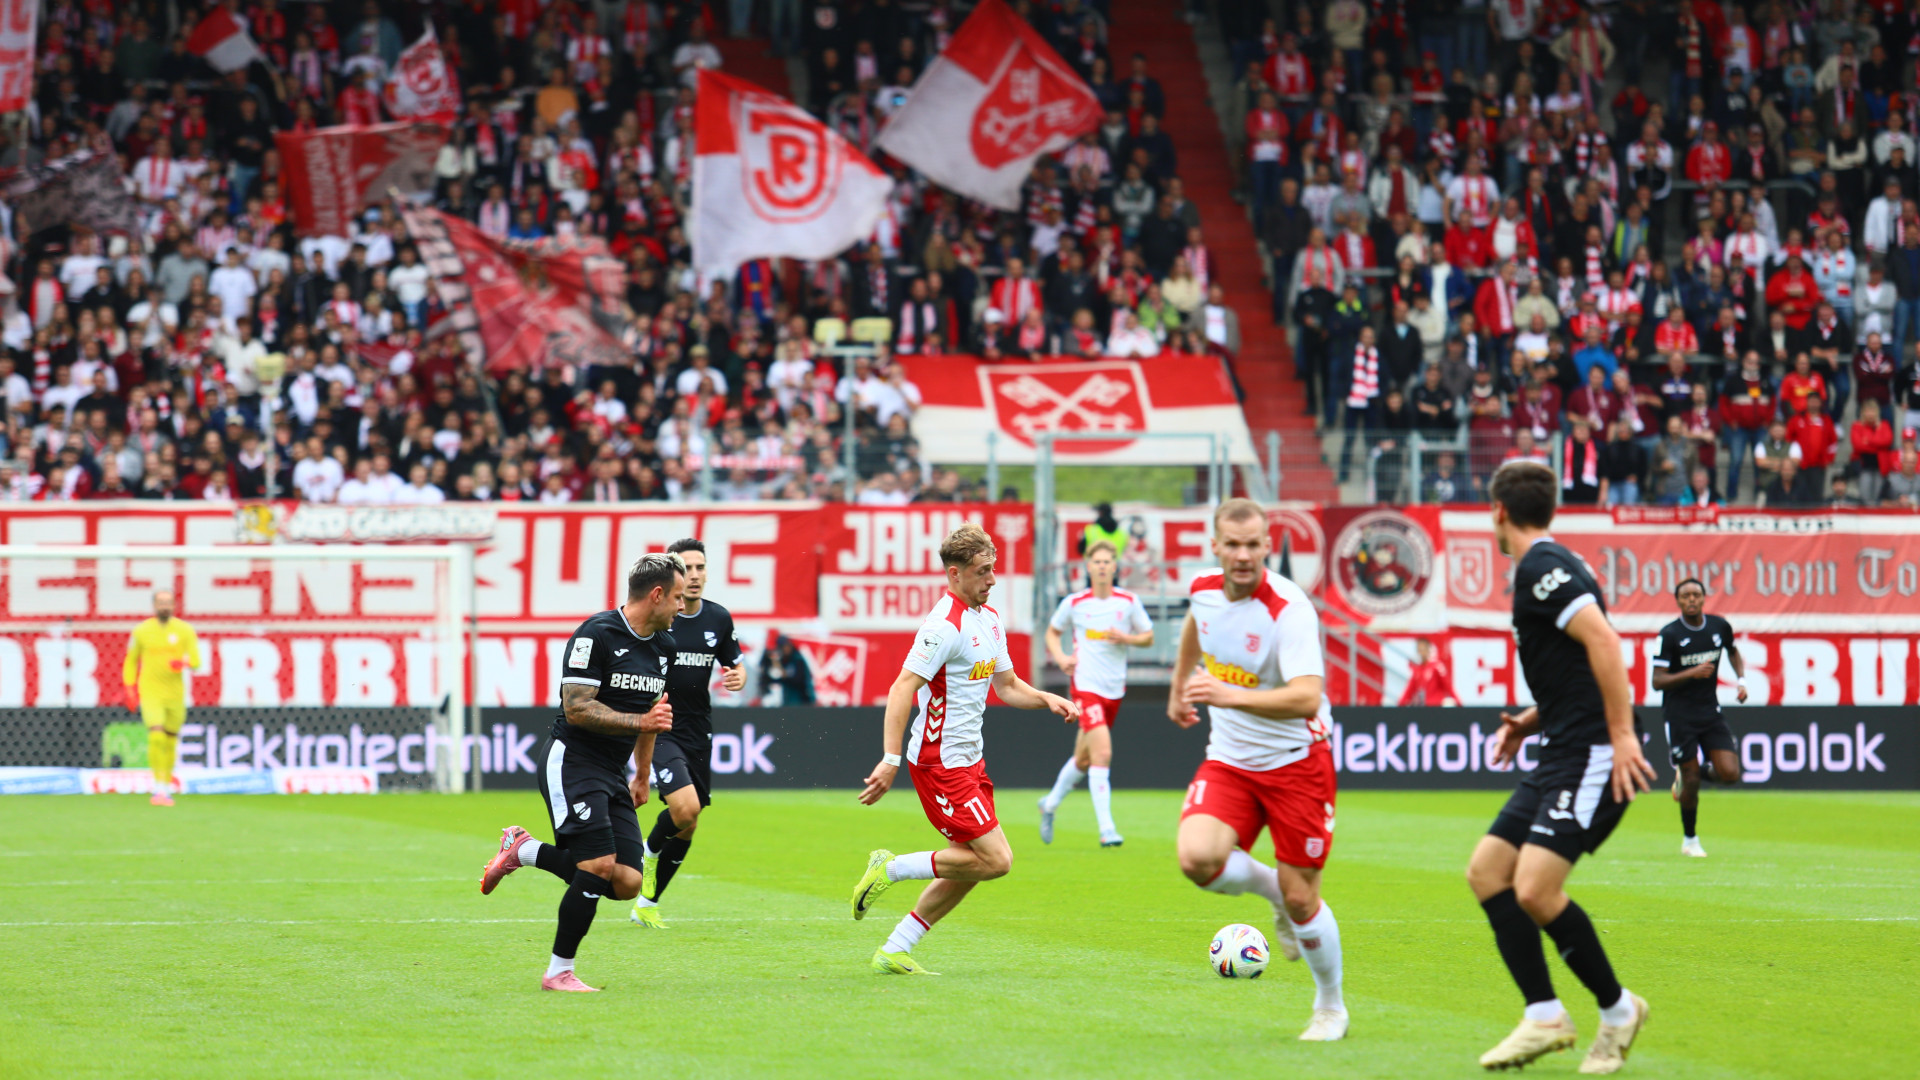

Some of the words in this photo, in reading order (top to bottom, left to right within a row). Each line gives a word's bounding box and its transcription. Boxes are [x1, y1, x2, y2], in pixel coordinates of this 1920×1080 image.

[1599, 546, 1742, 604] Power
[1755, 552, 1838, 597] vom
[610, 673, 666, 693] BECKHOF
[1202, 651, 1259, 688] Netto
[1741, 722, 1886, 783] golok
[964, 797, 991, 825] 11
[1557, 790, 1572, 810] 5
